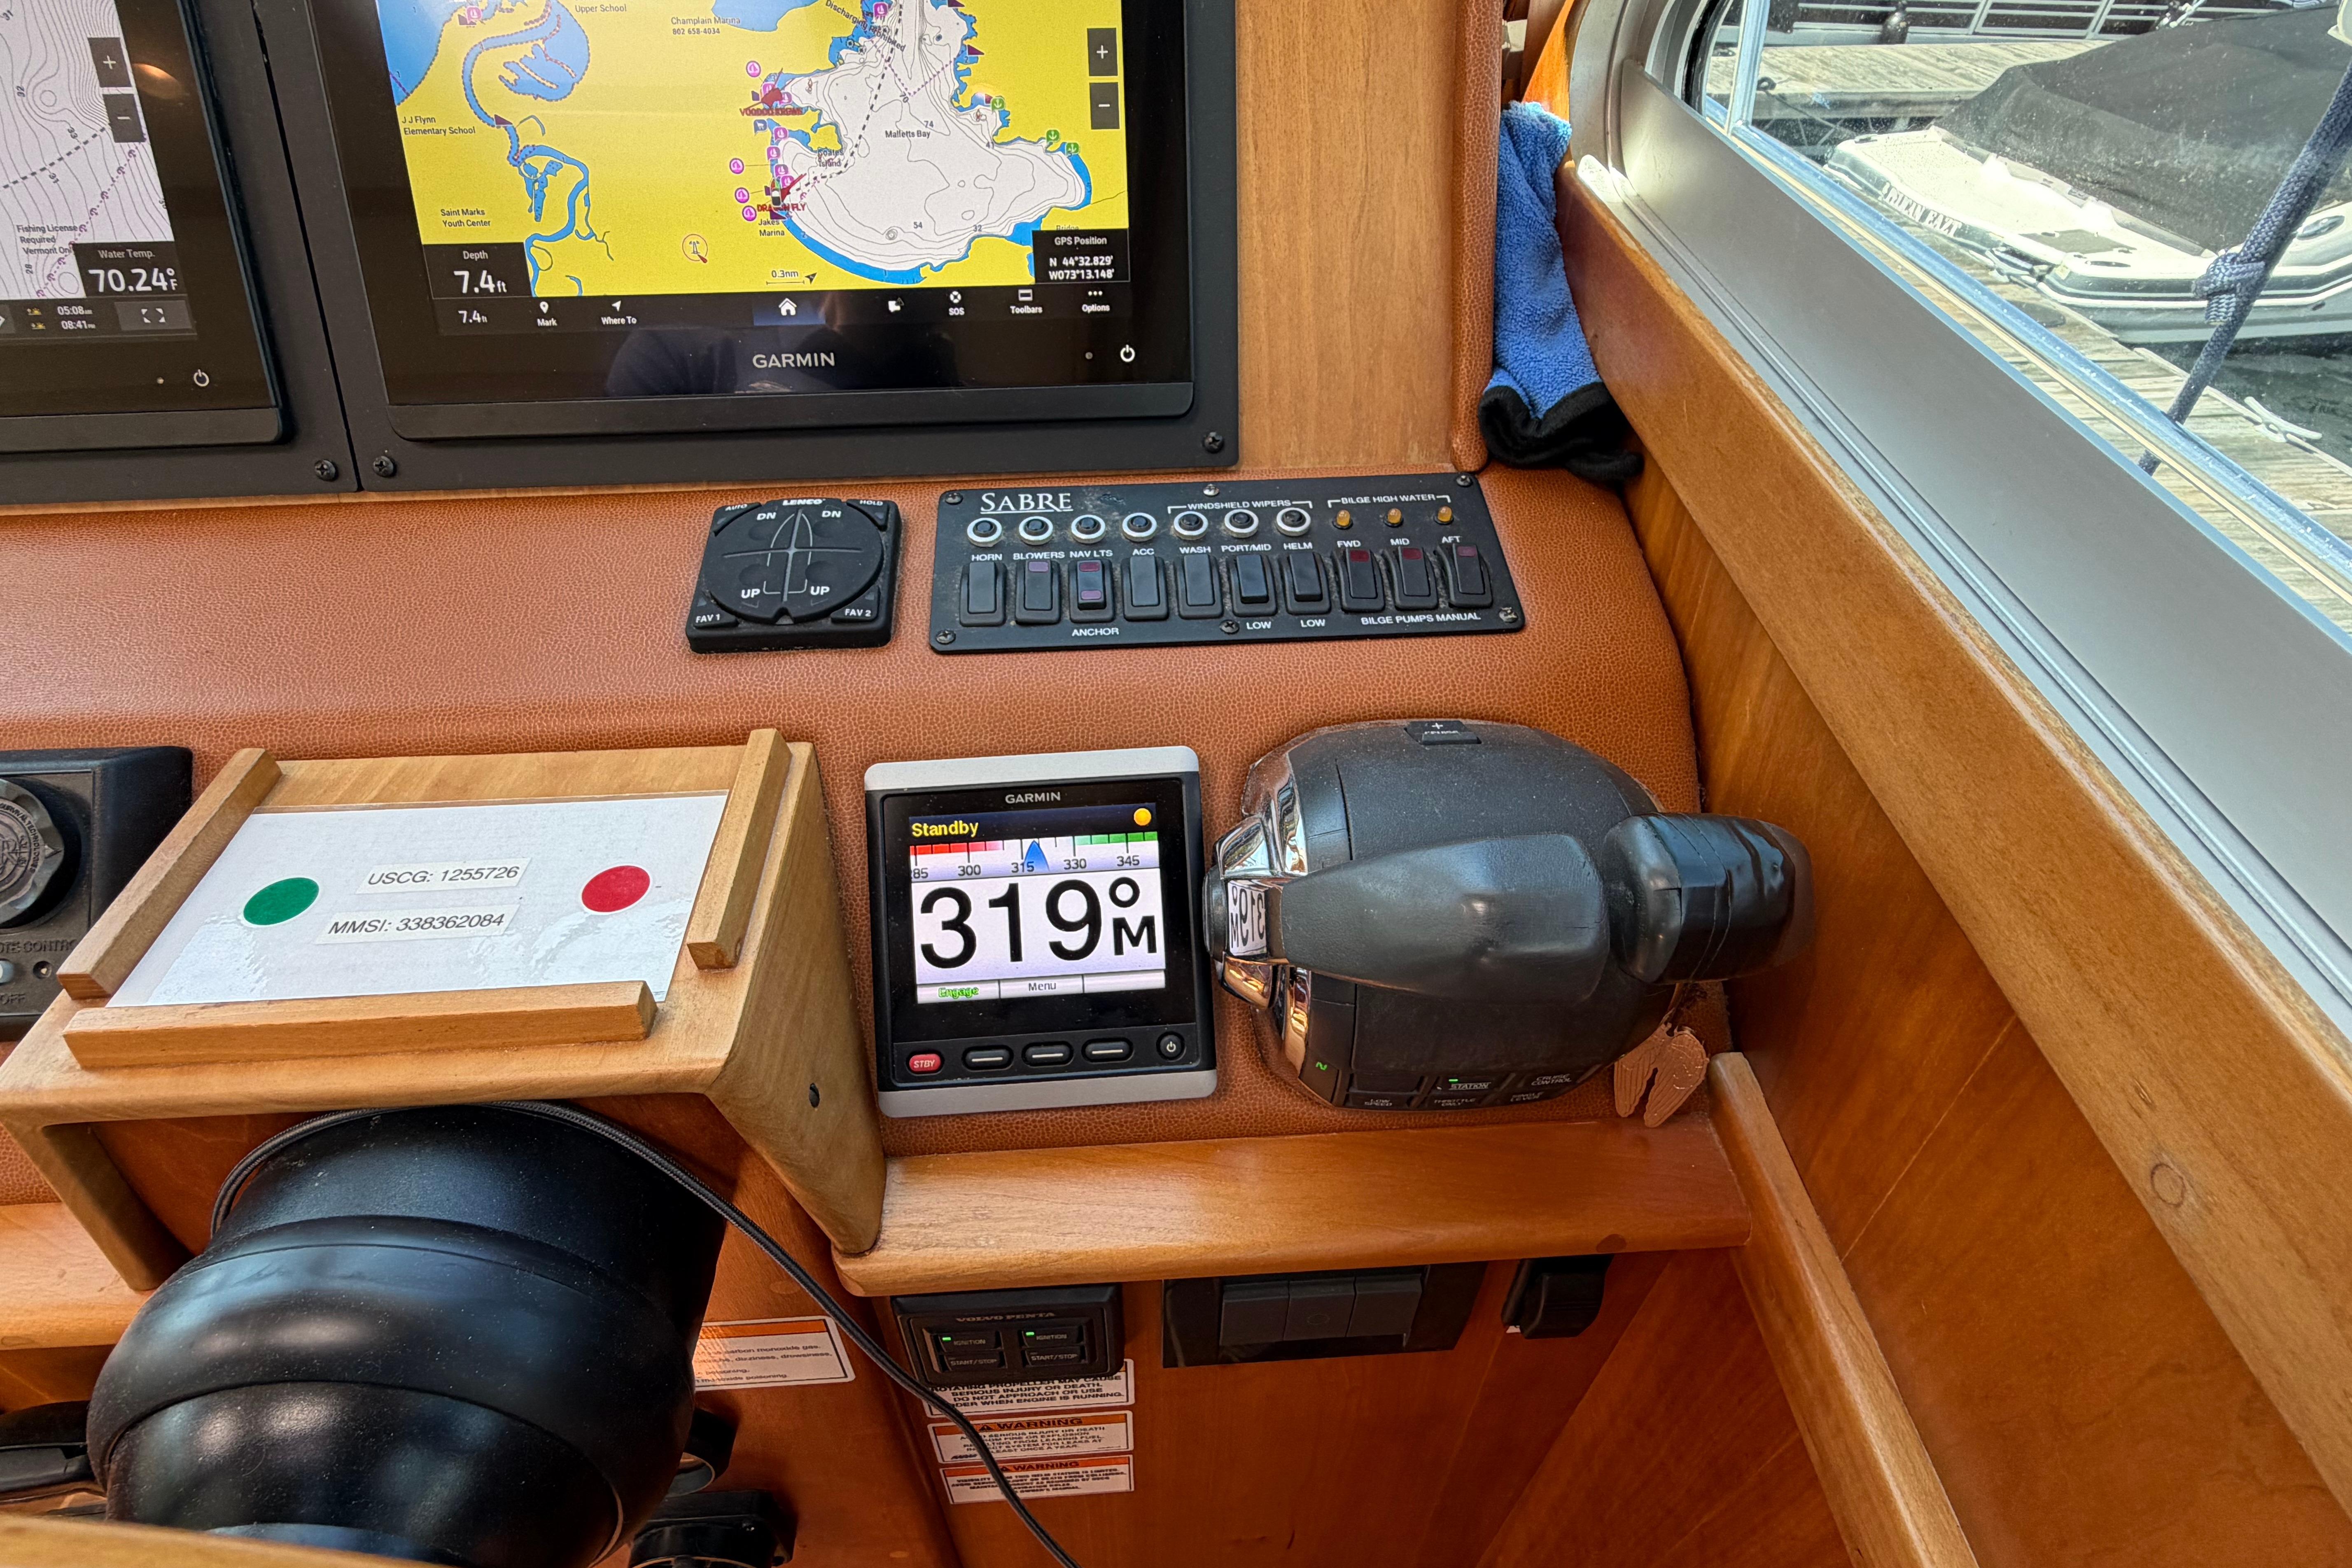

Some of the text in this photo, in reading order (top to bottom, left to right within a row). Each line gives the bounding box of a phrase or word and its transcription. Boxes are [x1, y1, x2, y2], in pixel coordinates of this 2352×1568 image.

[575, 4, 627, 14] Upper School
[671, 17, 712, 26] Champlain
[415, 115, 436, 125] Flynn
[404, 126, 476, 136] Elementary School
[917, 131, 931, 139] Bay
[441, 208, 485, 217] Saint Marks
[443, 219, 491, 228] Youth Center
[17, 225, 46, 233] Fishing
[20, 235, 56, 245] Required
[1055, 236, 1108, 246] GPS Position
[98, 249, 156, 259] Water Temp.
[463, 250, 488, 261] Depth
[1049, 258, 1057, 267] N
[949, 307, 965, 316] SOS
[1010, 305, 1043, 314] Toolbars
[1082, 304, 1110, 314] Options
[537, 318, 558, 327] Mark
[601, 316, 637, 325] Where To
[753, 352, 835, 369] GARMIN
[981, 492, 1072, 512] SABRE
[1341, 496, 1371, 504] BILGE
[1399, 494, 1435, 502] WATER
[1188, 502, 1250, 510] WINDSHIELD
[1221, 543, 1272, 552] PORT/MID
[1013, 551, 1065, 560] BLOWERS
[741, 588, 761, 598] UP
[810, 586, 830, 595] UP
[695, 615, 714, 623] FAV
[1301, 619, 1325, 628] LOW
[1361, 612, 1481, 625] BILGE PUMPS MANUAL
[1246, 621, 1272, 630] LOW
[1072, 628, 1119, 637] ANCHOR
[1005, 791, 1061, 804] GARMIN
[912, 821, 979, 838] Standby
[911, 855, 1140, 879] 85 300 315 330 345
[368, 866, 520, 886] USCG: 1255726
[328, 913, 505, 935] MMSI: 338362084
[1029, 982, 1057, 992] Menu
[938, 987, 979, 999] Engage
[914, 1059, 935, 1068] STBY
[1531, 1078, 1572, 1087] CONTROL
[998, 1391, 1059, 1399] APPROACH
[997, 1417, 1083, 1429] WARNING
[1013, 1461, 1079, 1471] WARNING
